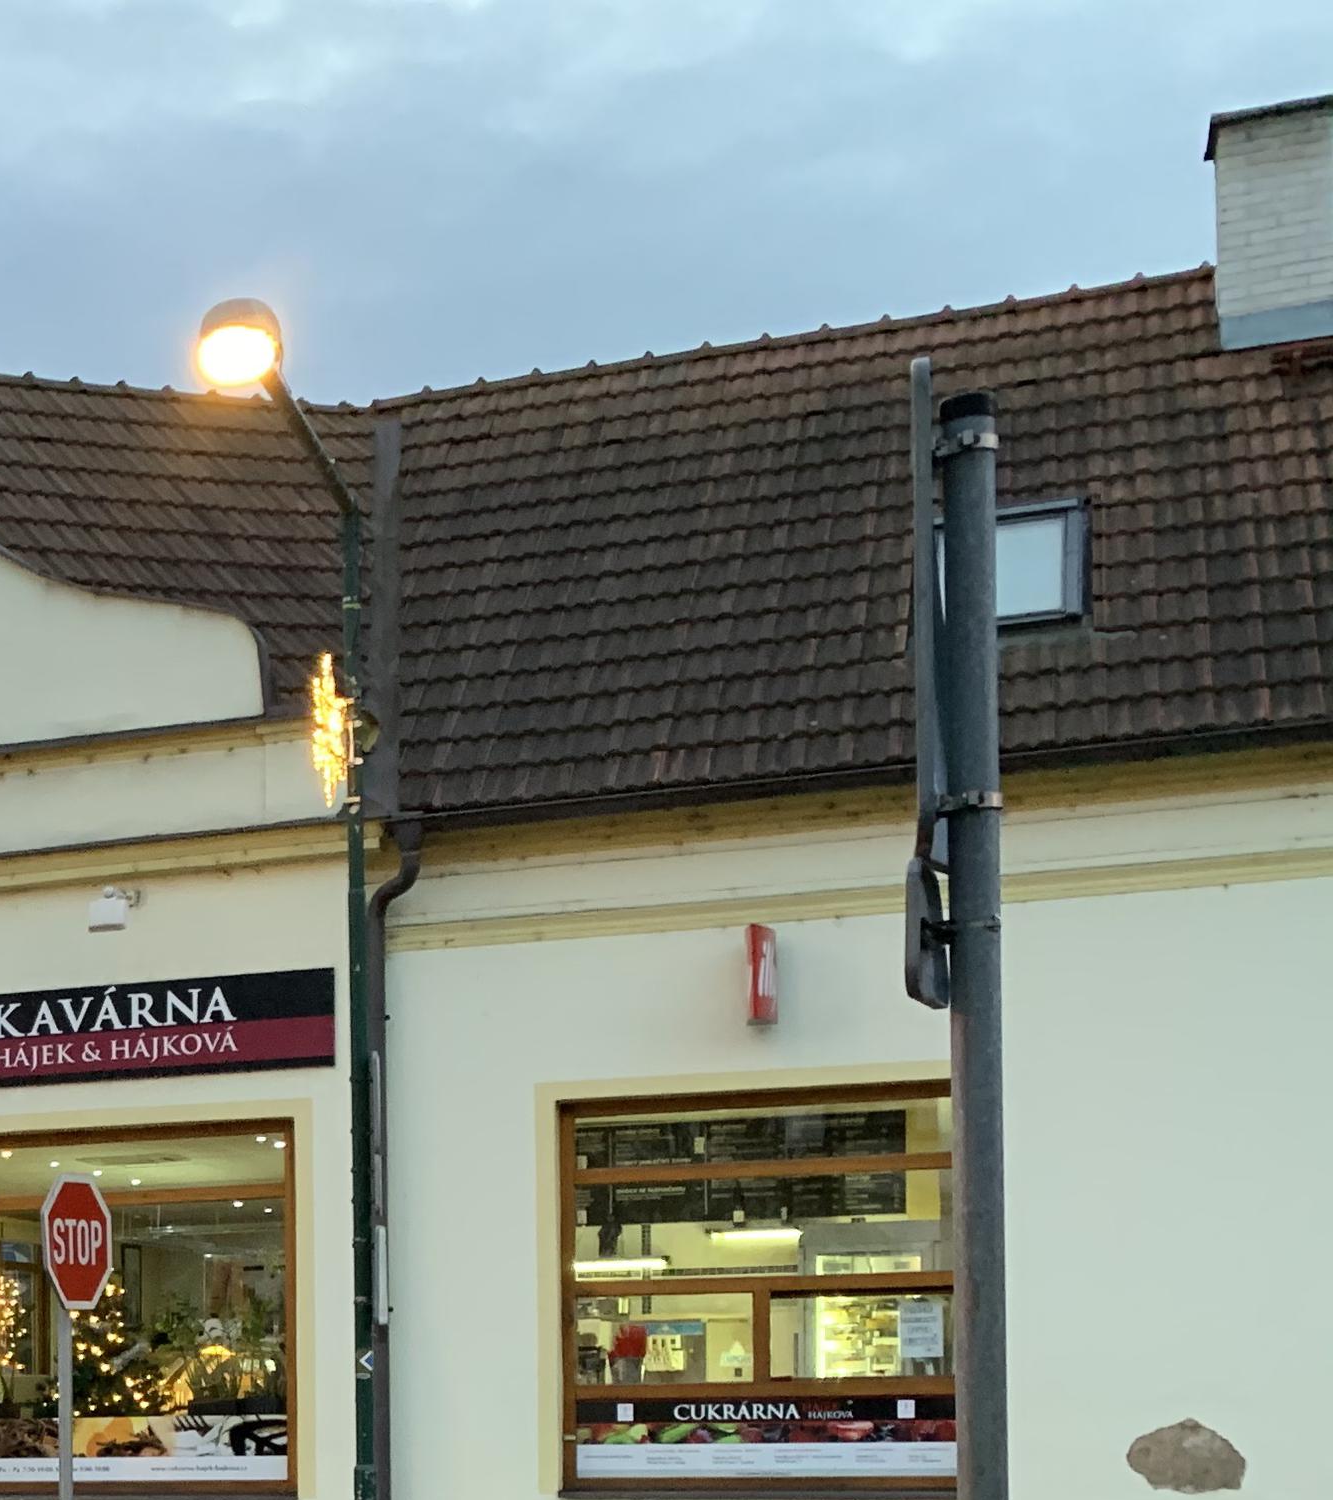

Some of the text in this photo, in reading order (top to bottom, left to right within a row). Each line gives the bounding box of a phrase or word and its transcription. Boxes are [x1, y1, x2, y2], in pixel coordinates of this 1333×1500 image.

[81, 1041, 102, 1063] &
[110, 1026, 239, 1064] HÁJKOVÁ
[53, 1217, 103, 1265] STOP
[673, 1400, 801, 1421] CUKRÁRNA
